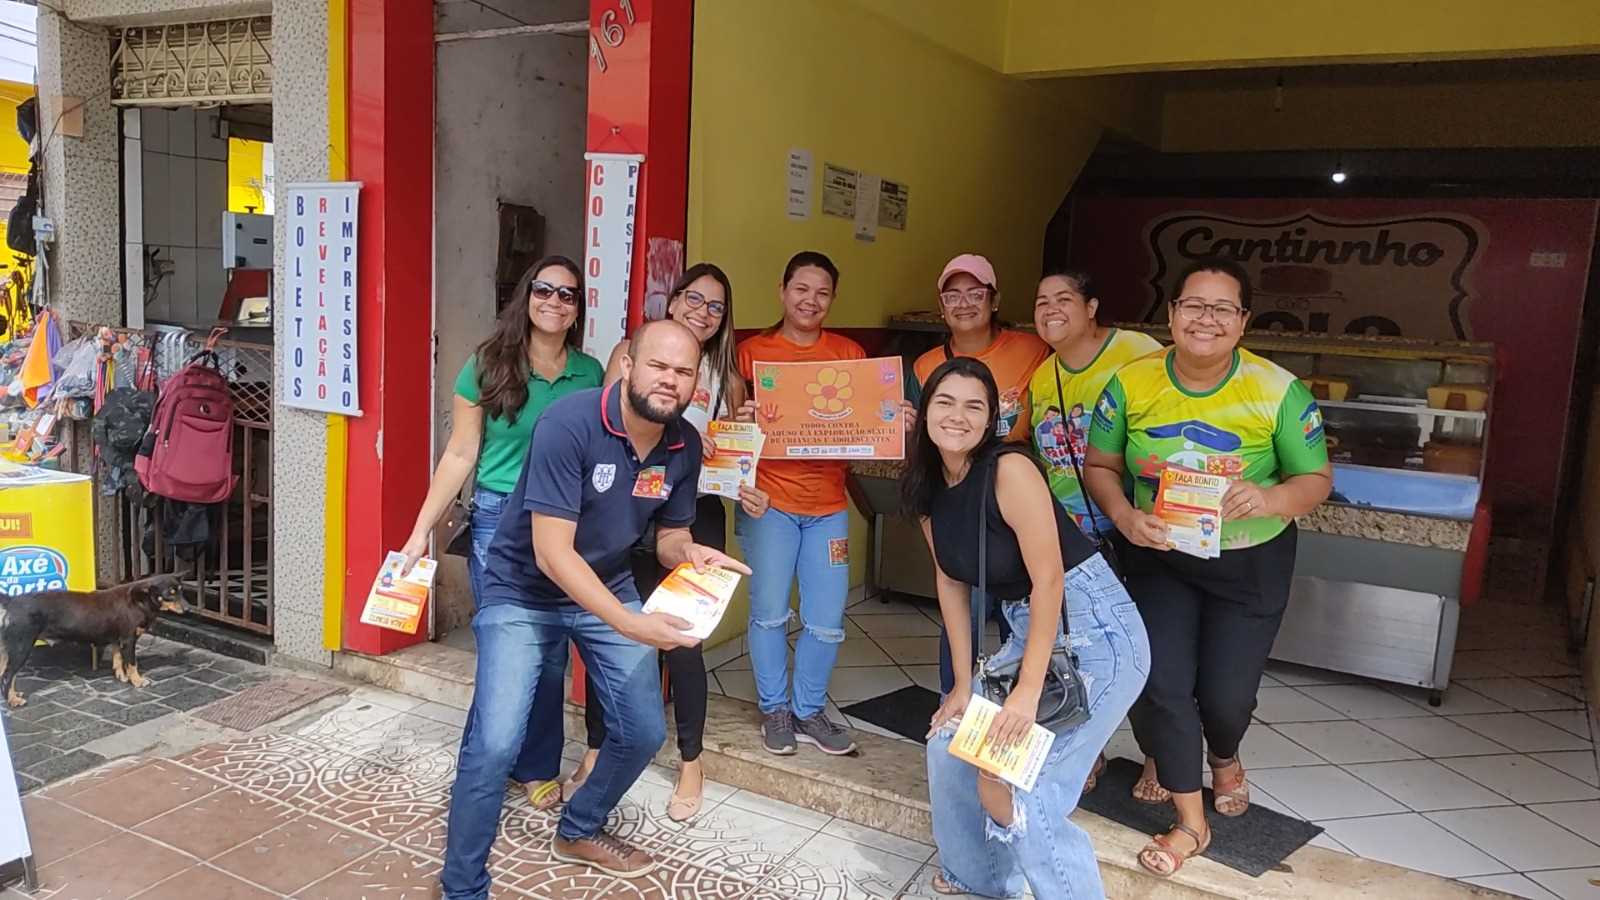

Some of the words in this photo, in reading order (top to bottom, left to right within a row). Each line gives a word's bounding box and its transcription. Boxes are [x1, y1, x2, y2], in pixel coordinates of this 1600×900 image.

[293, 195, 304, 398] BOLETOS
[318, 197, 328, 400] REVELAÇÃO
[341, 196, 353, 407] IMPRESSÃO
[585, 163, 605, 356] COLORI
[1, 553, 49, 576] Axé
